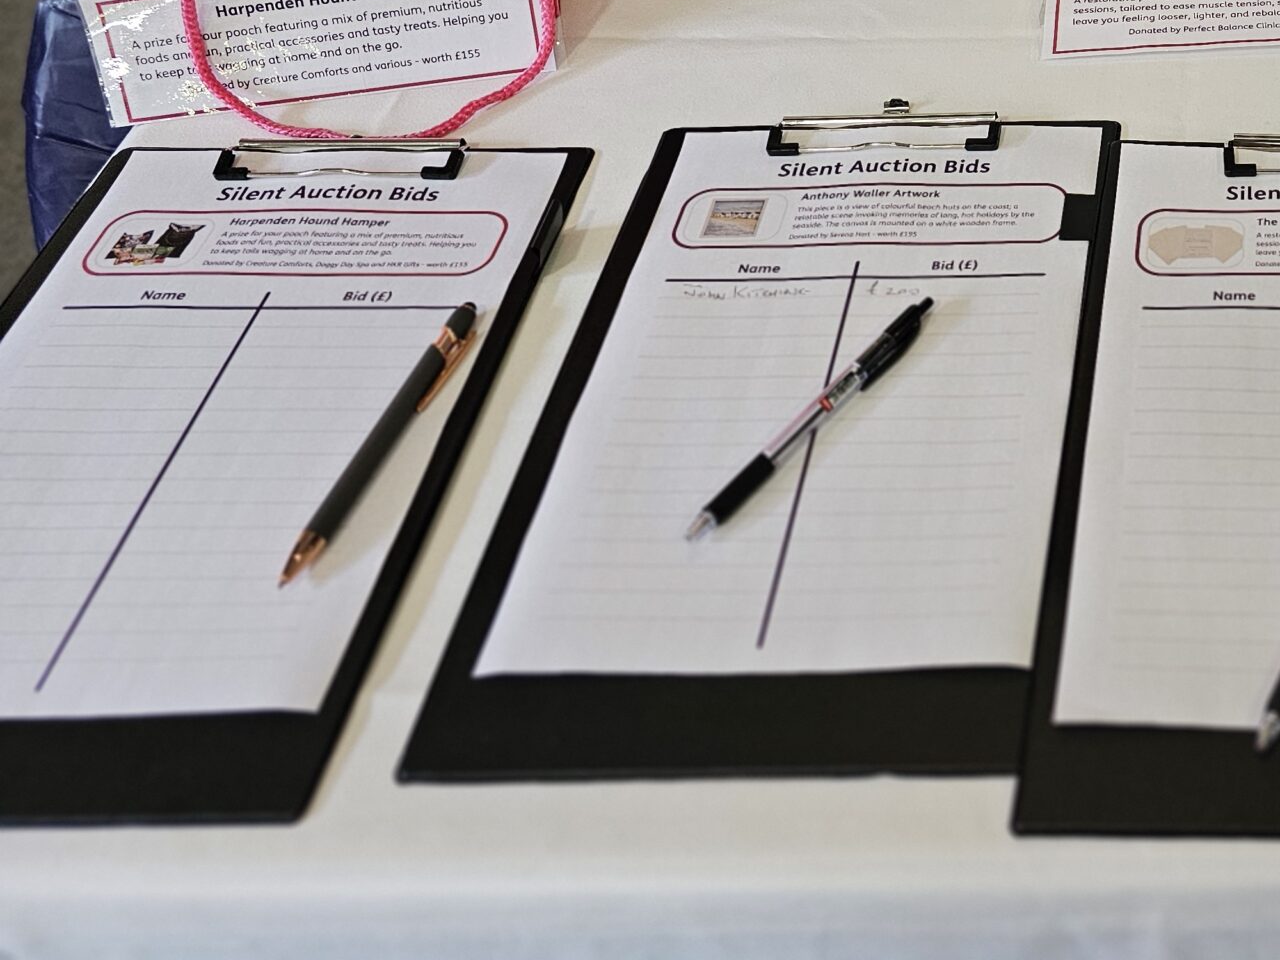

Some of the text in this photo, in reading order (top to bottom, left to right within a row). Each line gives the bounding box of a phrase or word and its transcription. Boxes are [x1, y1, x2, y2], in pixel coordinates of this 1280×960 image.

[132, 40, 141, 50] A
[143, 37, 173, 51] prize
[200, 31, 222, 40] our
[225, 24, 262, 41] pooch
[264, 19, 319, 33] featuring
[321, 18, 329, 26] a
[331, 13, 353, 25] mix
[356, 10, 368, 22] of
[370, 6, 426, 23] premium,
[428, 0, 483, 13] nutritious
[778, 158, 990, 177] Silent Auction Bids
[216, 184, 440, 202] Silent Auction Bids
[801, 189, 940, 201] Anthony Waller Artwork
[229, 216, 390, 228] Harpenden Hound Hamper
[1257, 217, 1278, 226] The
[738, 264, 781, 273] Name
[931, 260, 978, 271] Bid (£)
[140, 290, 186, 300] Name
[342, 291, 393, 303] Bid (£)
[1213, 291, 1256, 301] Name
